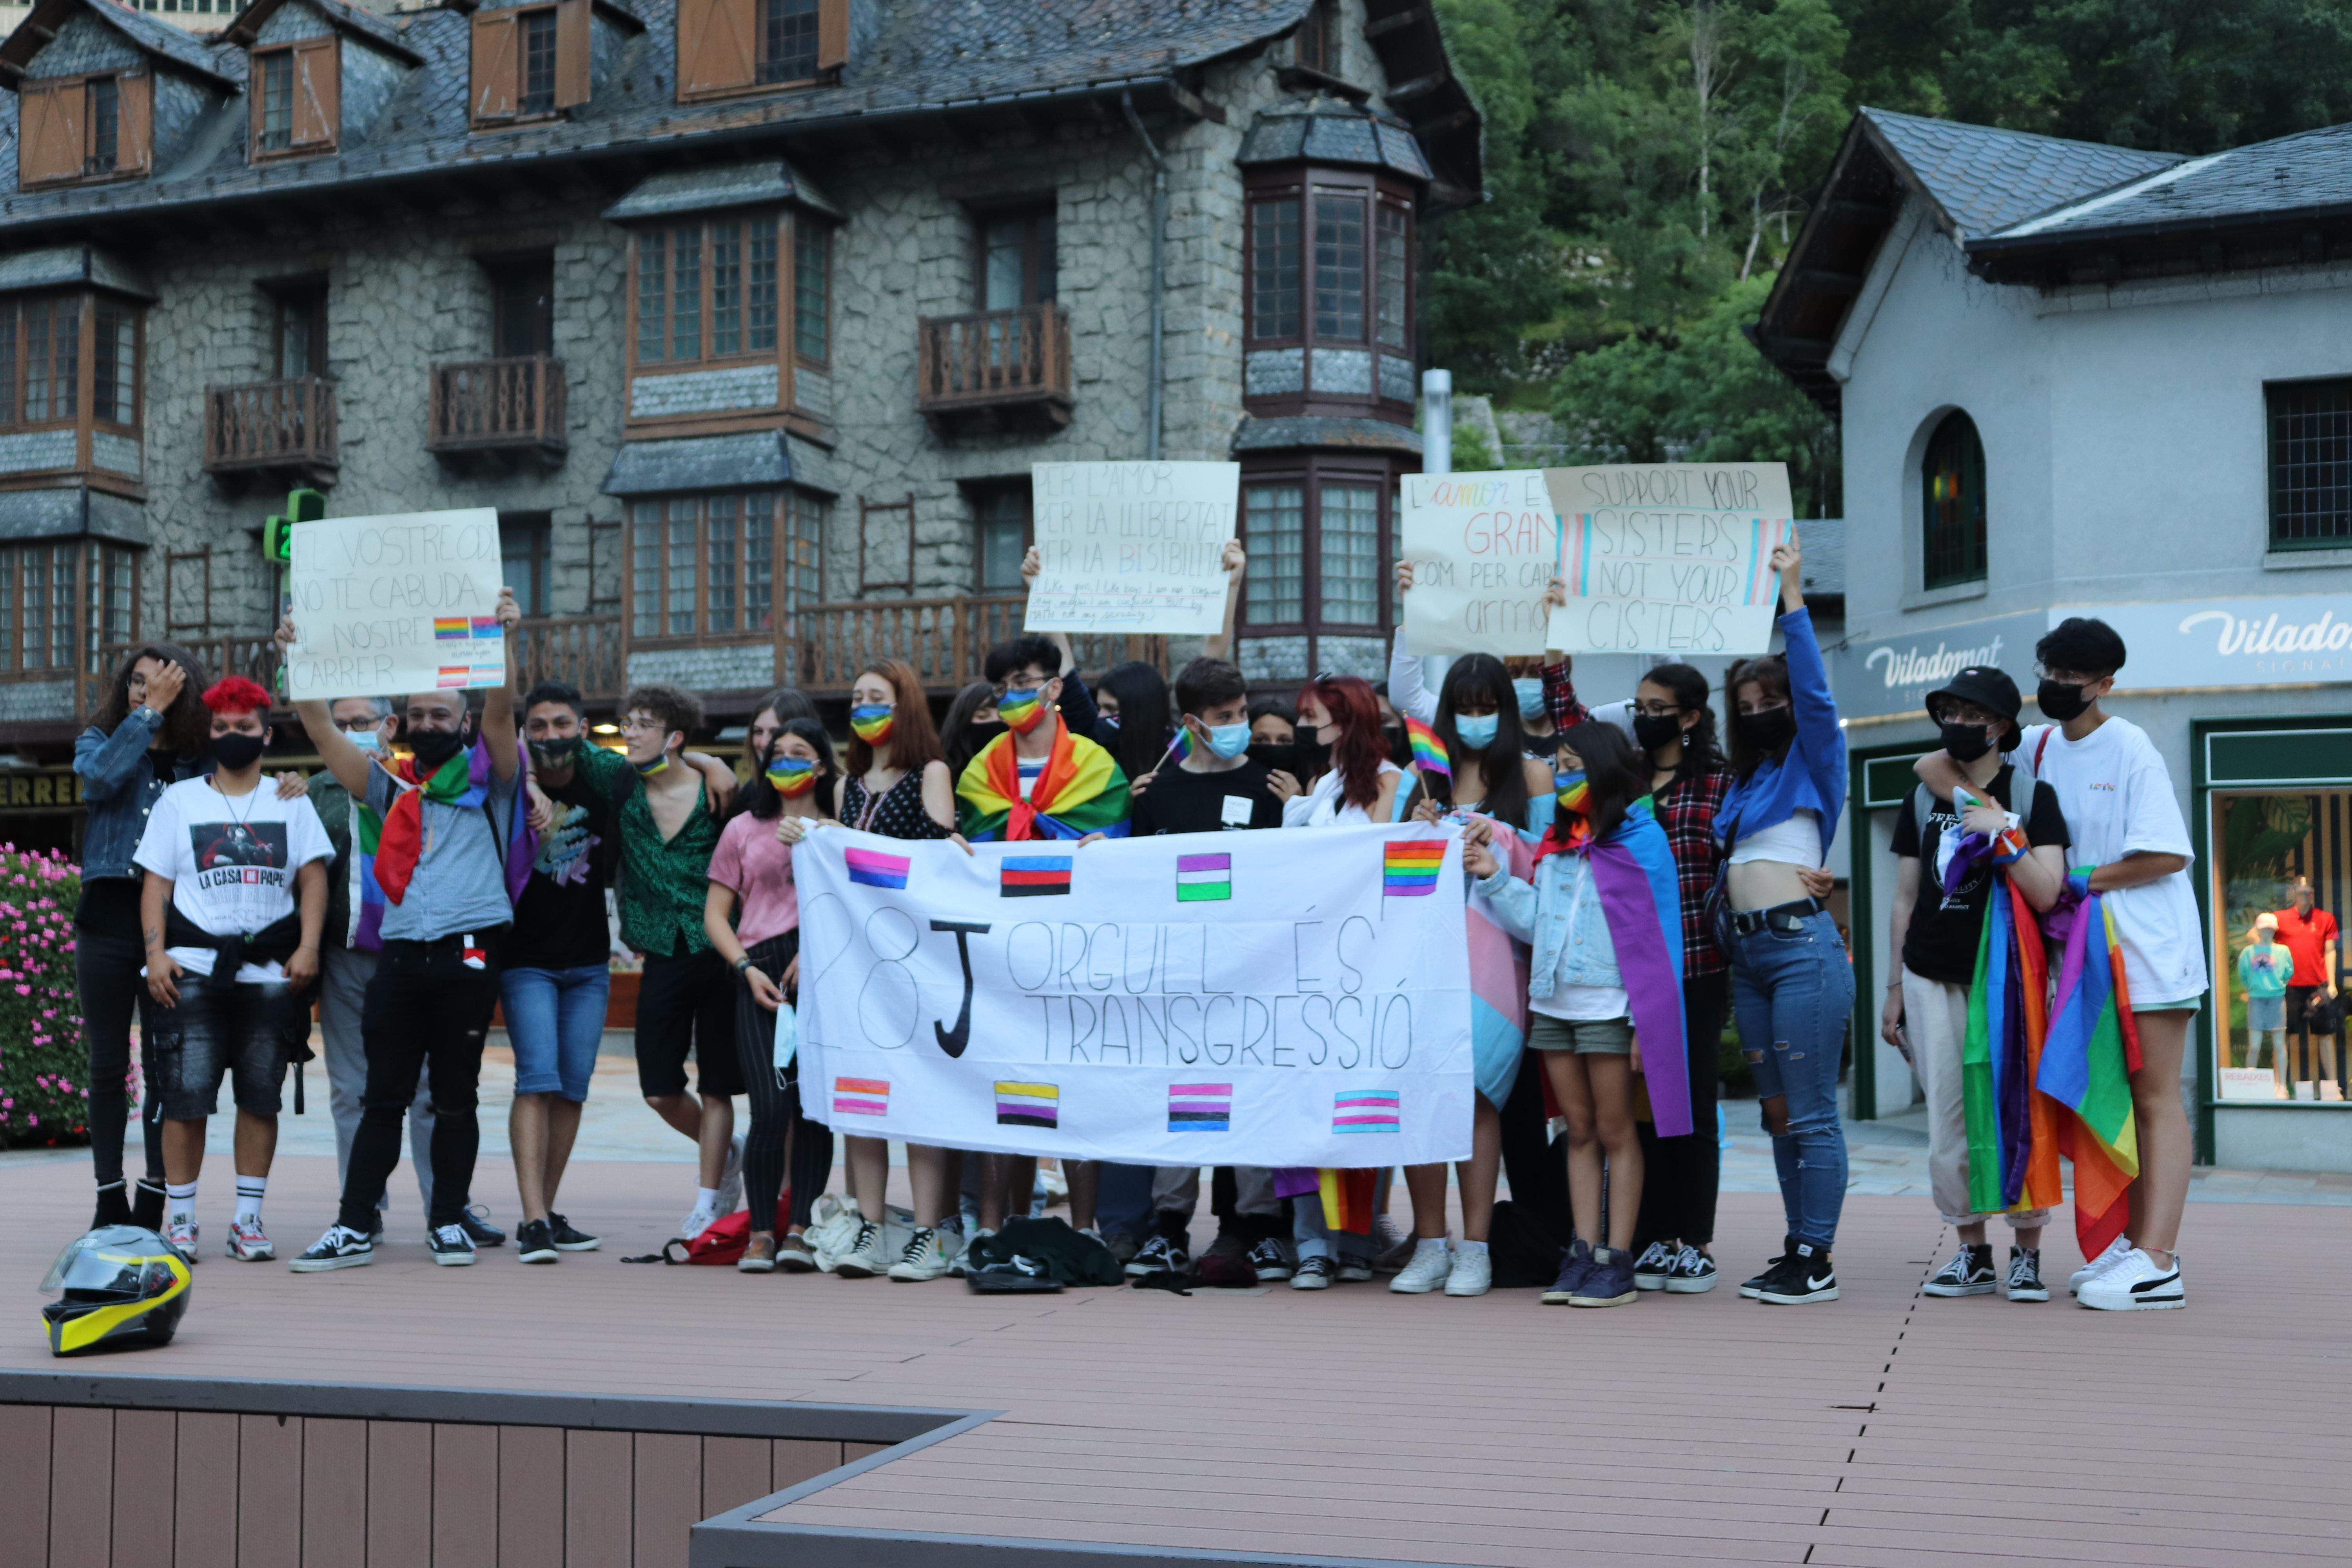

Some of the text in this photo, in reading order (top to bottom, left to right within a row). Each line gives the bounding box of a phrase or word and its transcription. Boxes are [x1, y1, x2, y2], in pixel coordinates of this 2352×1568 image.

[1036, 462, 1173, 497] PER L'AMOR
[1583, 470, 1759, 510] SUPPORT YOUR
[1036, 501, 1232, 541] PER LA LLIBERTAT
[1594, 509, 1740, 561] SISTERS
[296, 524, 497, 572] EL VOSTRE ODI
[1083, 541, 1104, 573] LA
[1119, 542, 1222, 577] BISIBILITA
[295, 572, 480, 612] NO TÉ CABUDA
[1412, 560, 1552, 588] COM PER CAB
[1600, 561, 1738, 603] NOT YOUR
[1166, 597, 1185, 606] BUT
[292, 617, 428, 659] AL NOSTRE
[1586, 601, 1732, 650] CISTERS
[2179, 610, 2352, 655] Vilado
[293, 654, 394, 690] CARRER
[1866, 635, 2004, 688] Viladomat
[2256, 657, 2345, 673] SIGNAT
[198, 873, 211, 889] LA
[213, 869, 242, 886] CASA
[260, 869, 285, 887] PAPE
[803, 893, 1375, 1058] 28J ORGULL ÉS
[1025, 978, 1412, 1069] TRANSGRESSIÓ
